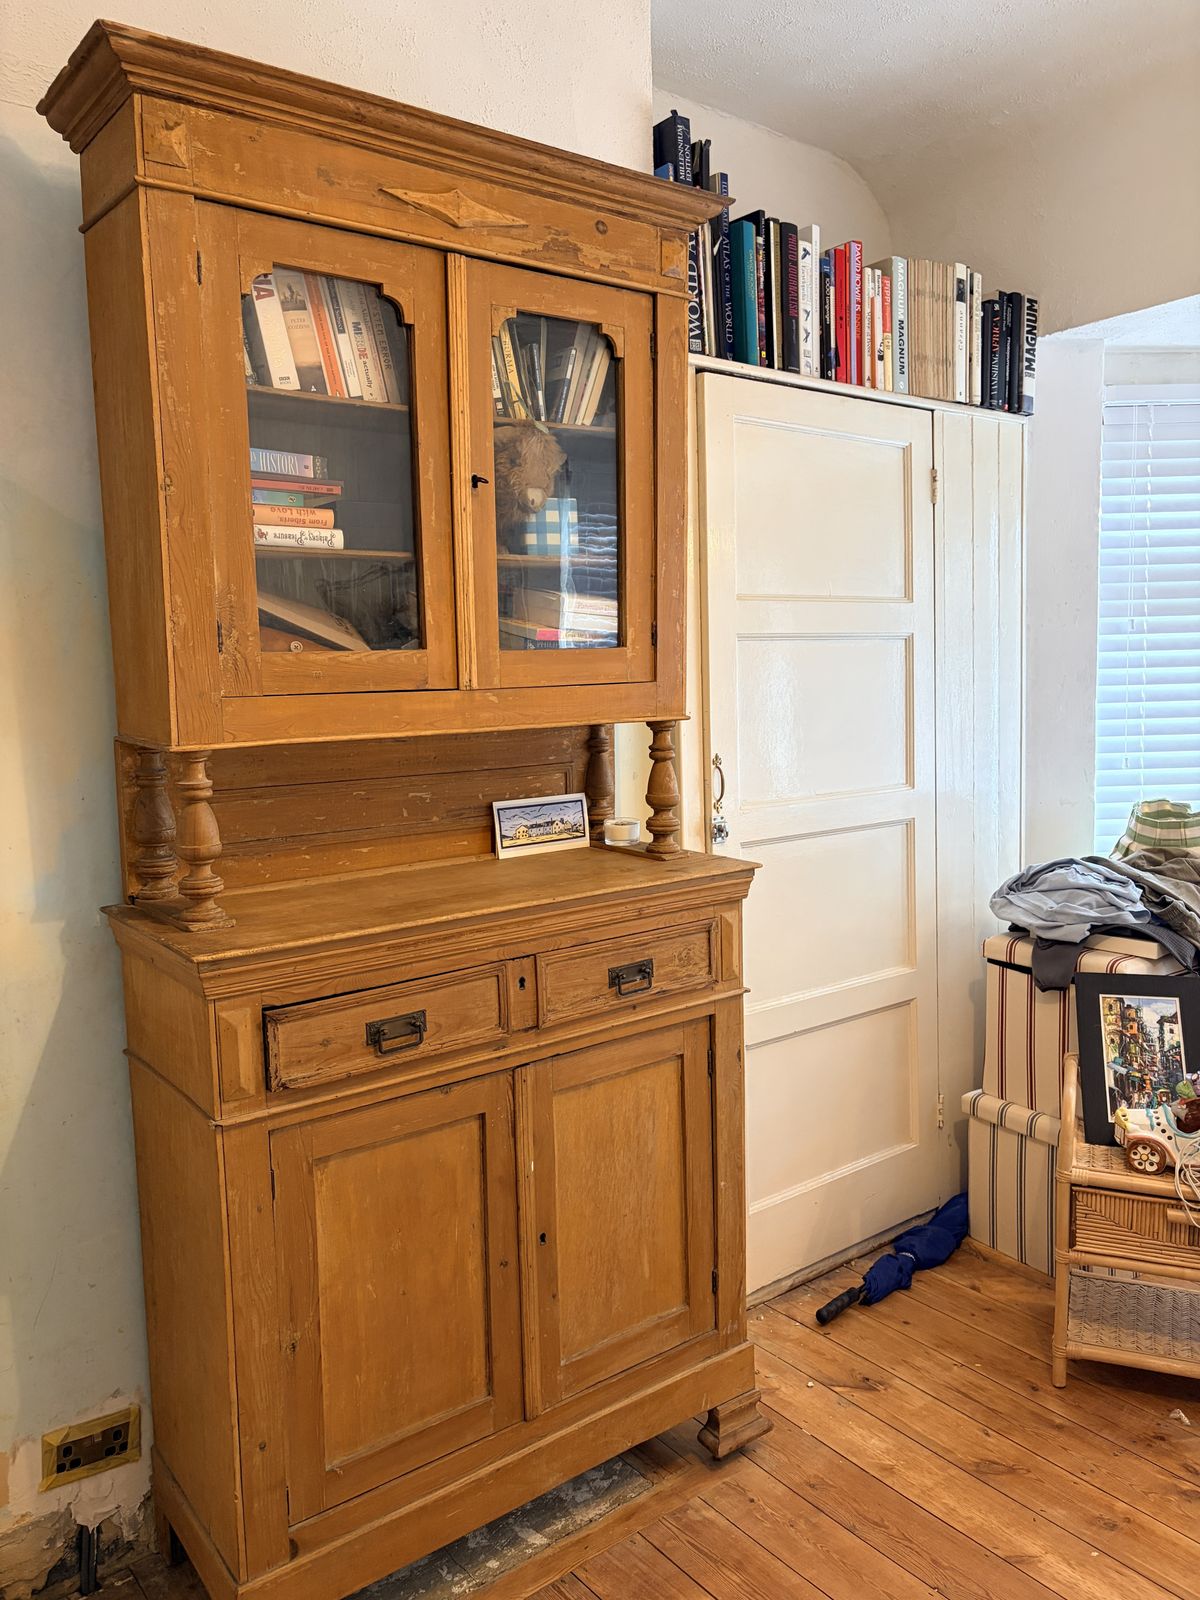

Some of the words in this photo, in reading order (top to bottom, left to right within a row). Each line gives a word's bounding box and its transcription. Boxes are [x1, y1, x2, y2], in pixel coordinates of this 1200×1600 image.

[677, 124, 686, 181] MILLENNIUM
[684, 144, 692, 182] EDITION
[722, 235, 731, 271] ATLAS
[788, 233, 798, 260] PHOTO
[725, 272, 731, 281] OF
[789, 261, 799, 318] JOURNALISM
[855, 273, 863, 303] BOWIE
[897, 262, 905, 320] MAGNUM
[688, 258, 701, 338] WORLD
[725, 302, 733, 344] WORLD
[992, 316, 1000, 352] AFRICA
[1025, 297, 1038, 373] MAGNUM
[378, 340, 392, 370] ERROR
[898, 319, 906, 376] MAGNUM
[363, 361, 373, 389] actually
[991, 353, 1000, 395] VANISHING
[260, 451, 300, 476] HISTORY
[270, 506, 293, 515] Love
[295, 508, 317, 517] with
[309, 519, 328, 527] From
[273, 530, 305, 546] Pleasure
